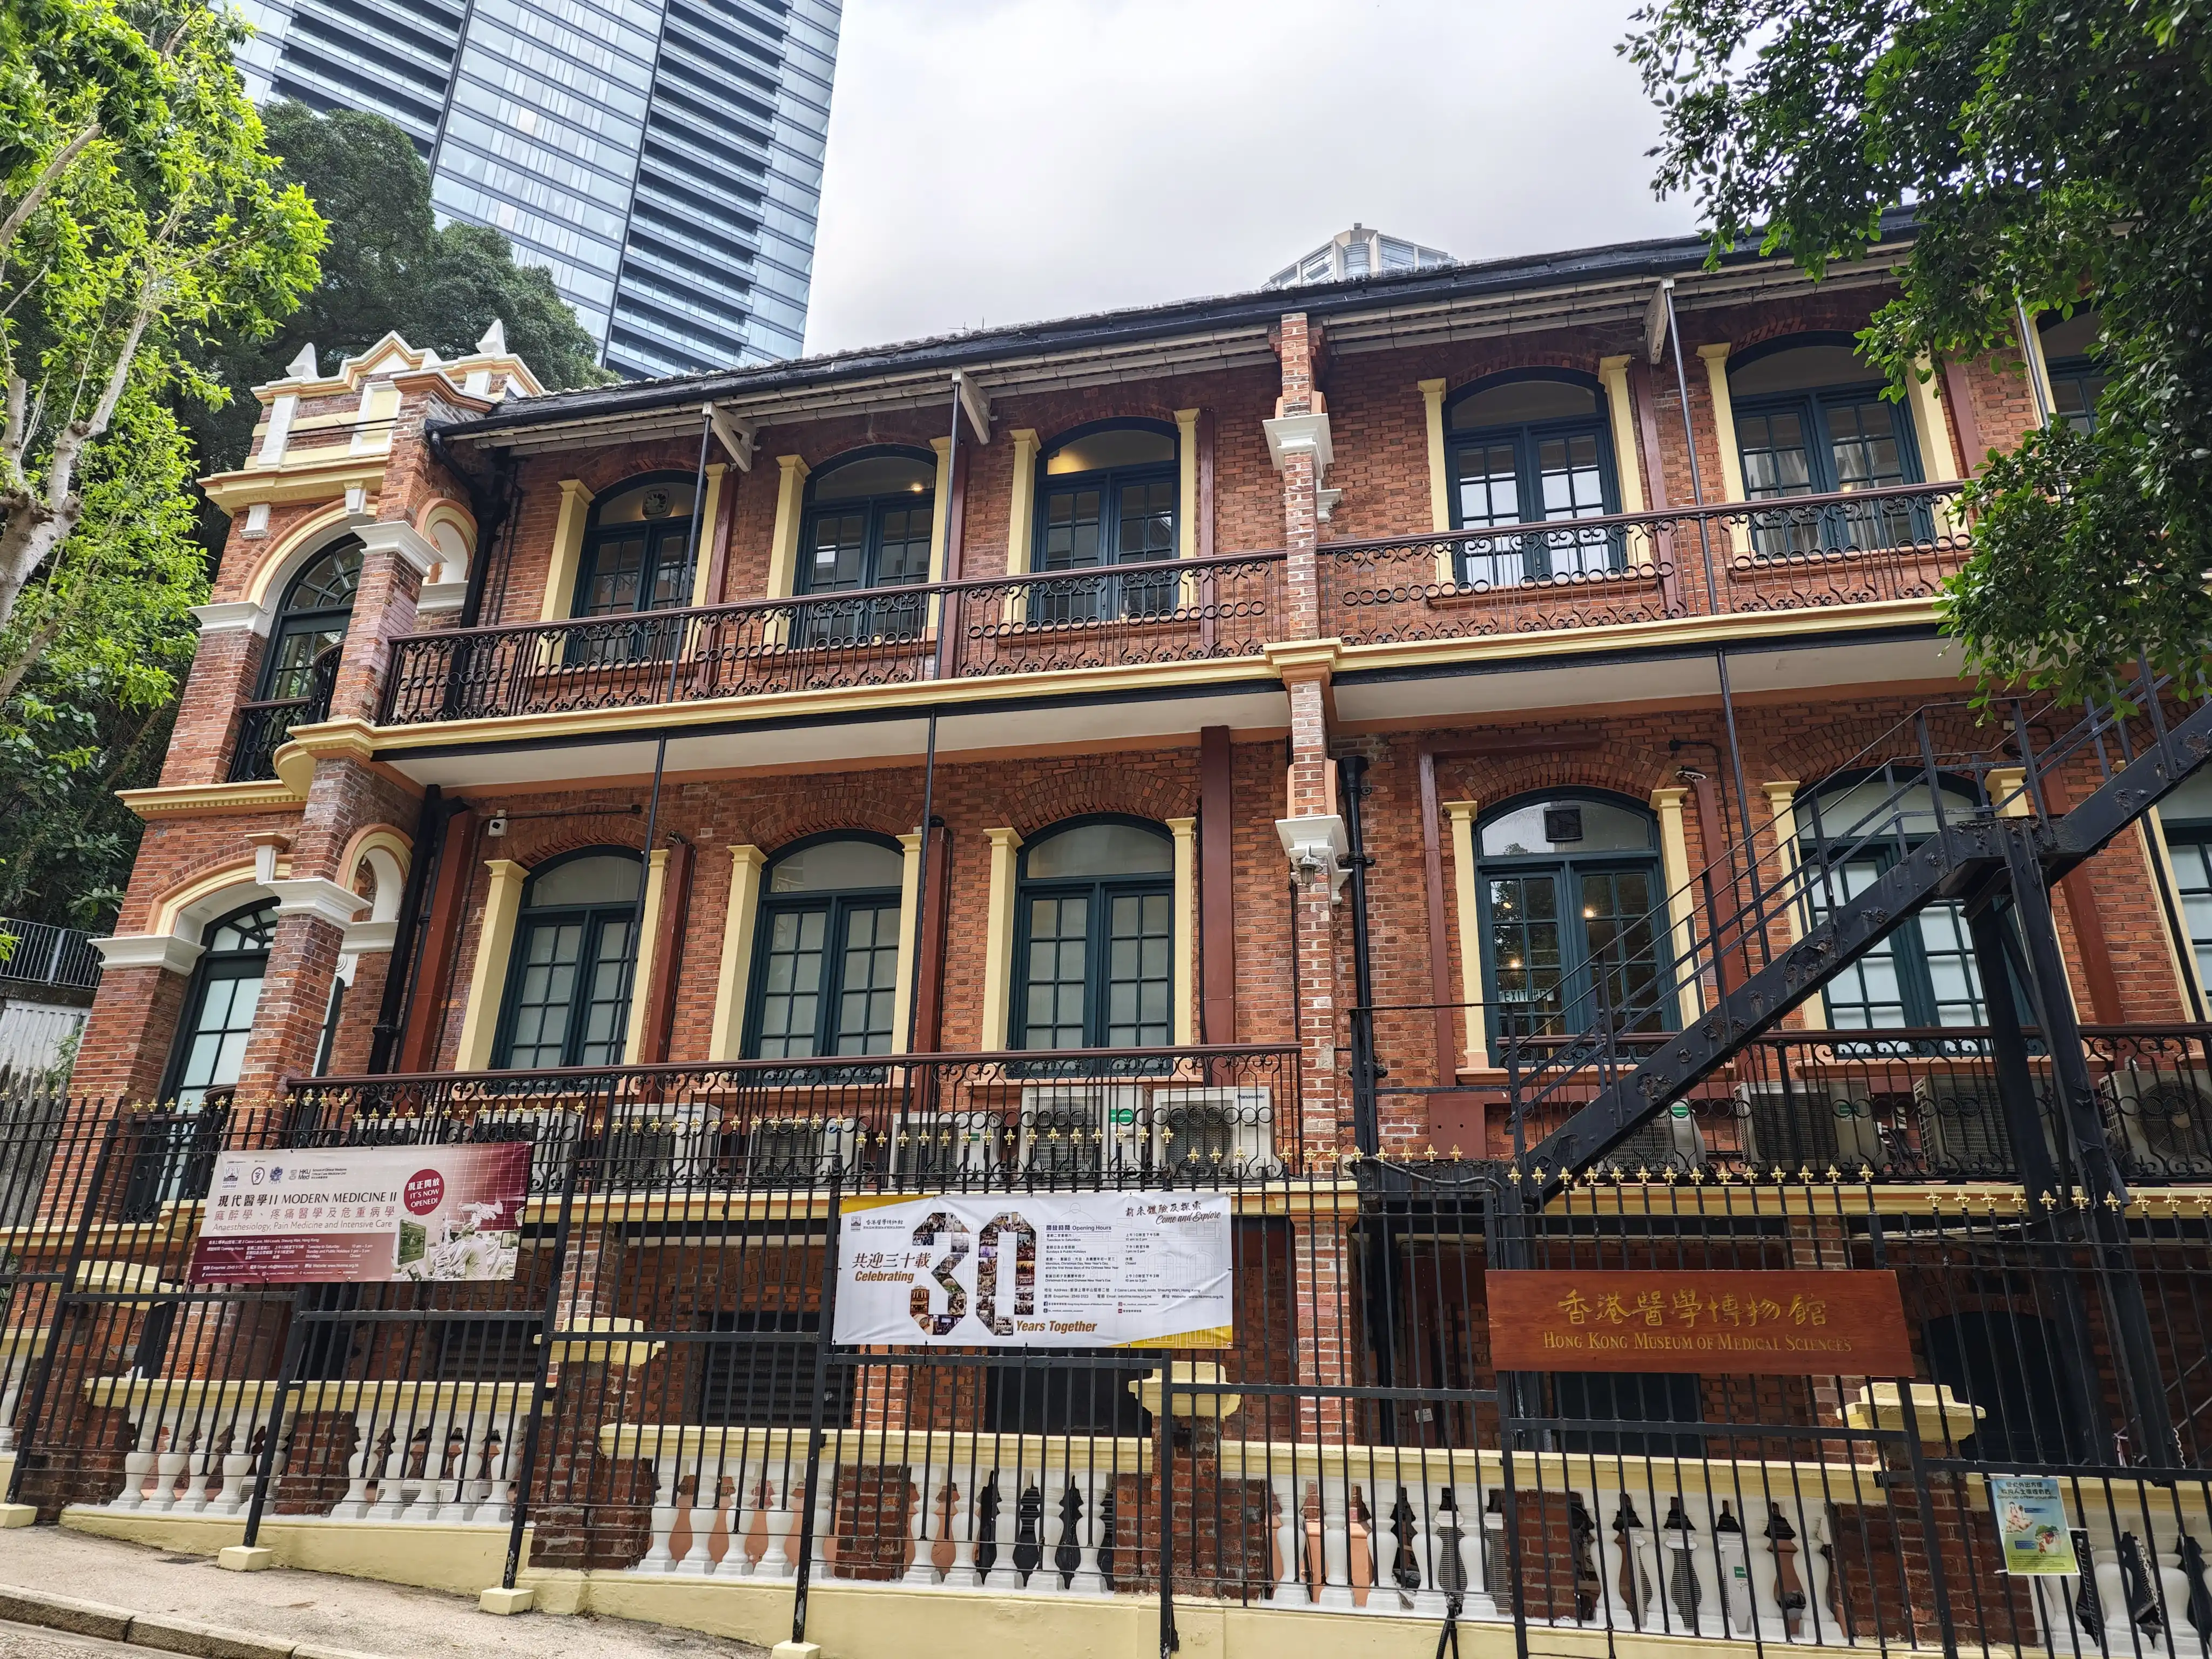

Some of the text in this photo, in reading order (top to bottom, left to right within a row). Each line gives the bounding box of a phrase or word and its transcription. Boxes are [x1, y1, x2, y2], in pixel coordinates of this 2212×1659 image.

[1504, 990, 1527, 1002] EXIT
[408, 1177, 440, 1191] 現正開放
[281, 1193, 329, 1204] MODERN
[332, 1192, 386, 1203] MEDICINE
[423, 1188, 440, 1197] NOW
[410, 1197, 438, 1208] OPENED!
[1156, 1210, 1222, 1225] Come and Explore
[212, 1219, 393, 1232] Anaesthesiology, Pain Medicine and Intensive Care
[852, 1252, 932, 1269] 共迎三十載
[855, 1271, 915, 1284] Celebrating
[910, 1212, 1036, 1336] 30
[1557, 1289, 1826, 1328] 香港醫學博物館
[1016, 1320, 1097, 1334] Years Together
[1544, 1331, 1583, 1348] HONG
[1587, 1331, 1628, 1349] KONG
[1634, 1332, 1693, 1350] MUSEUM
[1718, 1333, 1782, 1350] MEDICAL
[1785, 1334, 1852, 1352] SCIENCES
